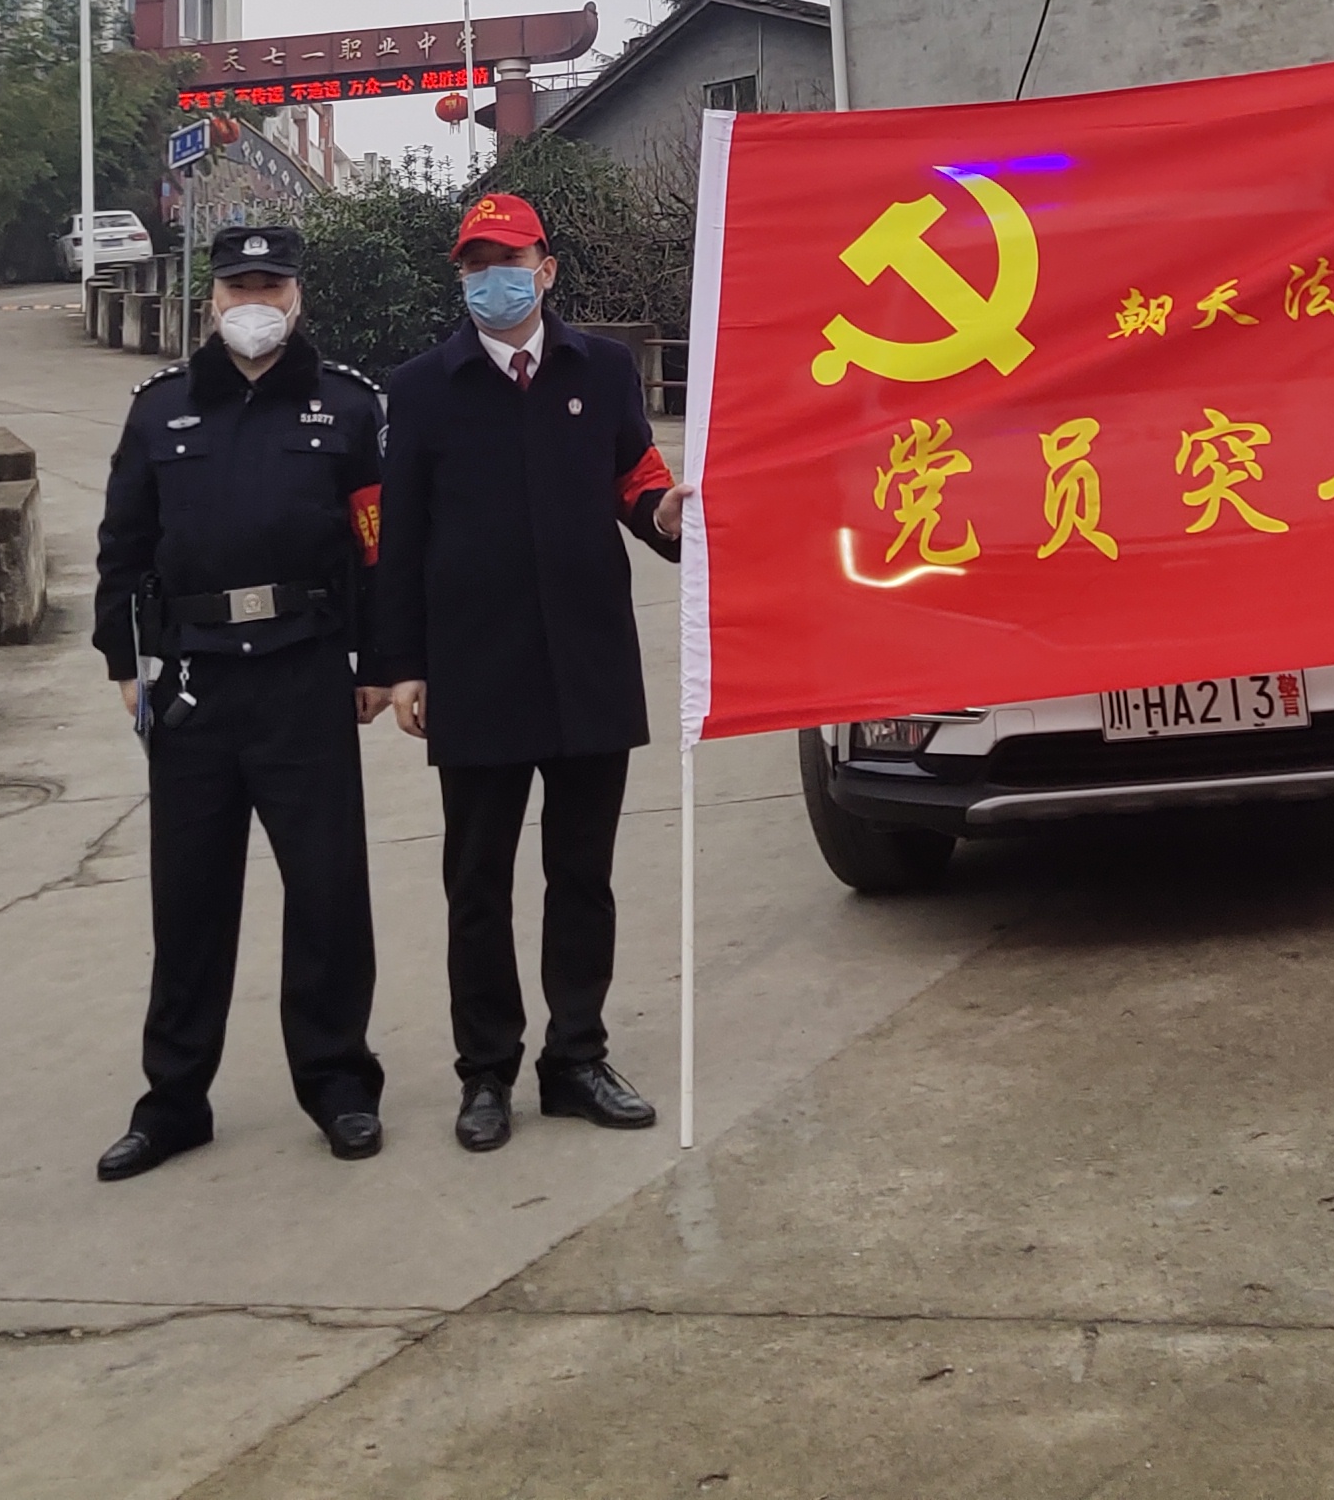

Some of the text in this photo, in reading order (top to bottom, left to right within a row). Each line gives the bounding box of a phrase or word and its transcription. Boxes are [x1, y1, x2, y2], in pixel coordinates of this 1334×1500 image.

[178, 27, 477, 73] 天七一职业中学
[348, 73, 415, 97] 万众一心
